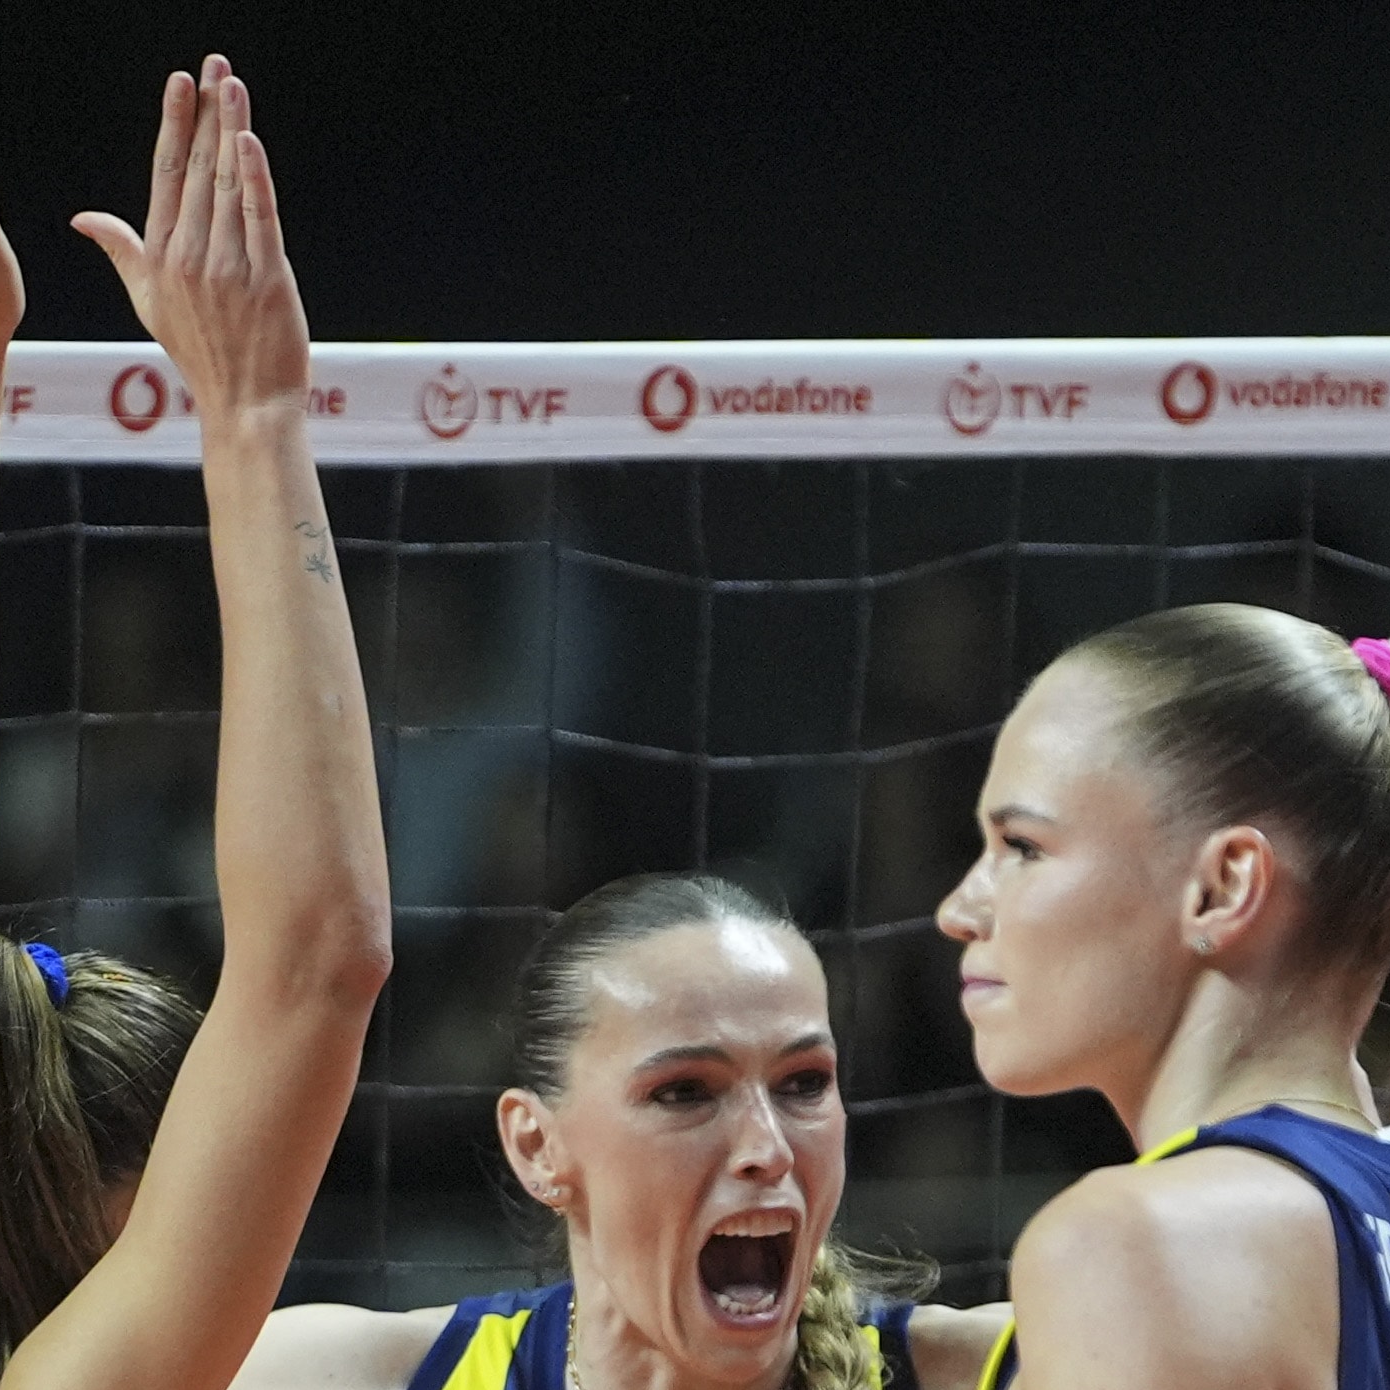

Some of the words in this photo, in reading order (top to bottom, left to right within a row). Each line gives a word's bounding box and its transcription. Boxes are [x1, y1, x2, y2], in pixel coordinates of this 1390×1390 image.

[487, 387, 568, 425] TVF
[707, 376, 872, 417] vodafone
[1011, 383, 1088, 422] TVF
[1228, 370, 1390, 410] vodafone
